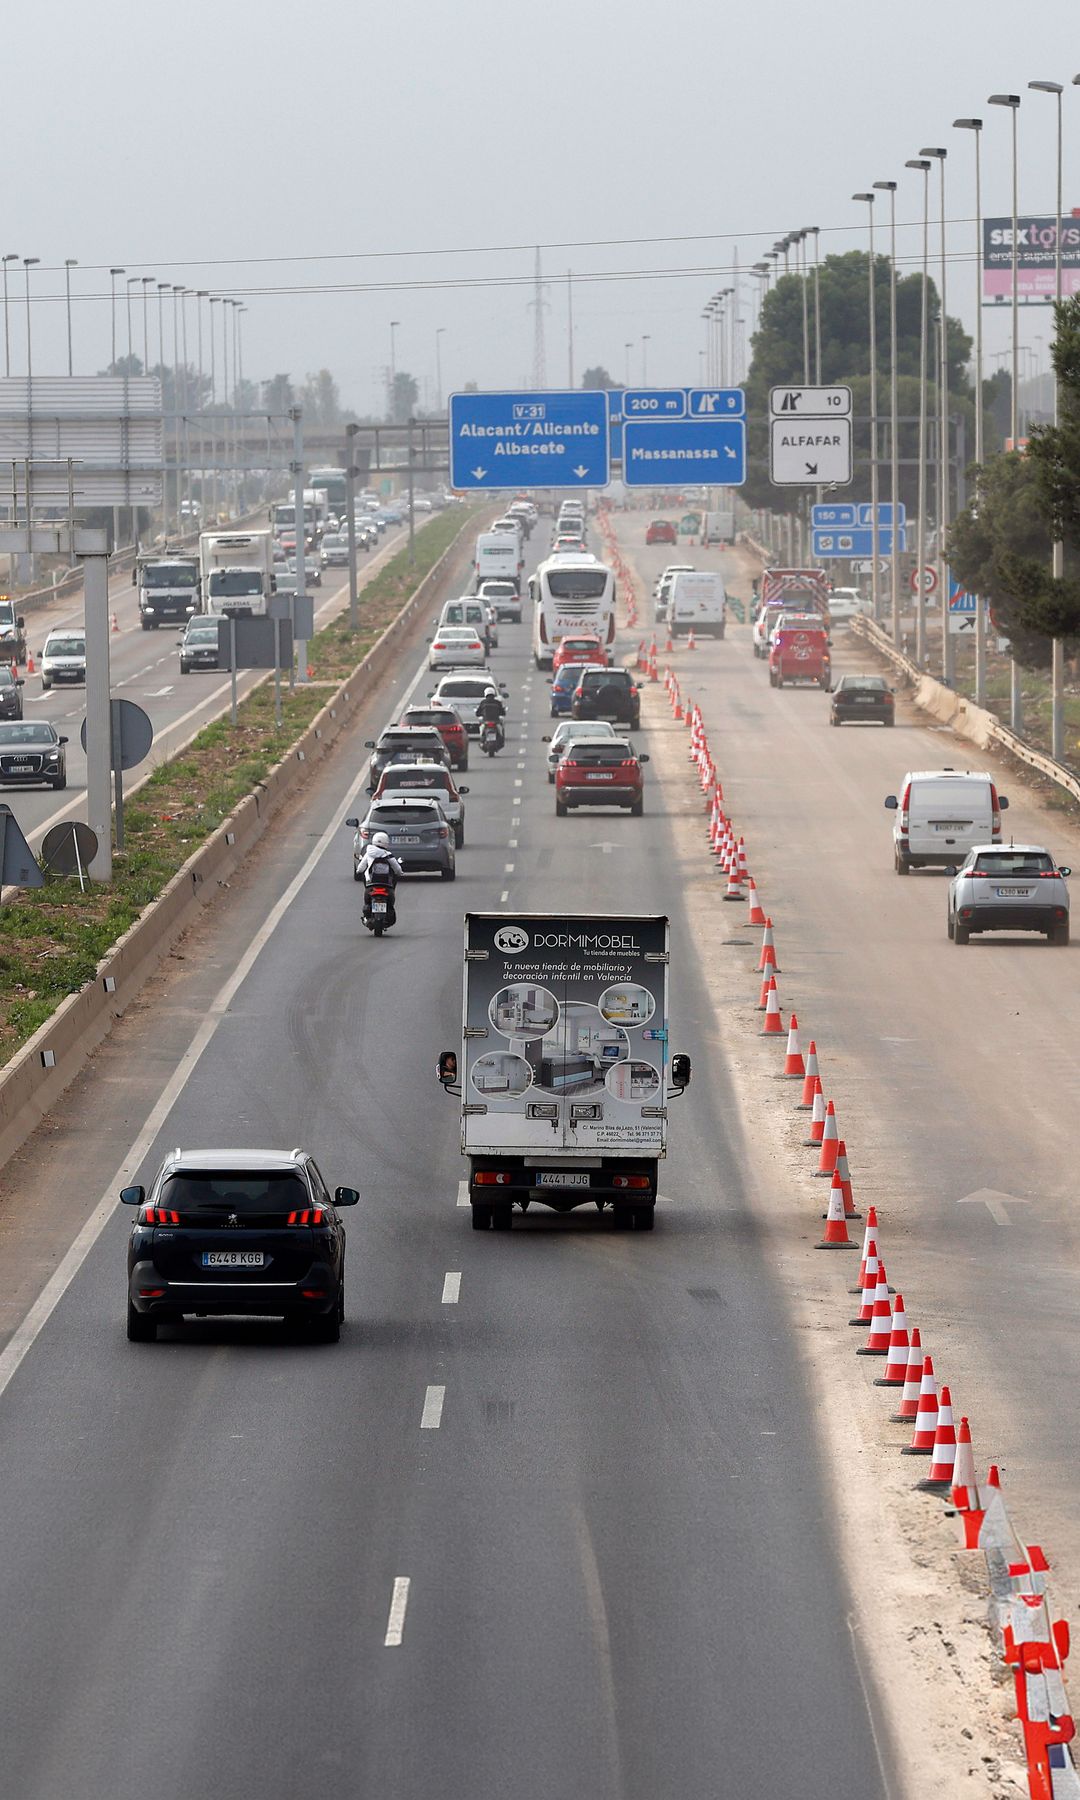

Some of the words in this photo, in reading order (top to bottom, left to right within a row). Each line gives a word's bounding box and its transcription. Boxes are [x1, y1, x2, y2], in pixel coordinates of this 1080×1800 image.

[631, 399, 659, 410] 200
[665, 400, 677, 409] m
[727, 397, 736, 408] 9
[827, 396, 841, 406] 10
[515, 406, 544, 417] V-31
[460, 422, 599, 437] Alacant/Alicante
[781, 435, 841, 447] ALFAFAR
[494, 441, 565, 456] Albacete
[631, 448, 719, 460] Massanassa
[817, 511, 836, 520] 150
[840, 512, 851, 520] m
[533, 934, 641, 949] DORMIMOBEL
[503, 962, 512, 970] Tu
[542, 962, 568, 971] tienda
[570, 962, 581, 971] de
[583, 962, 625, 971] mobiliario
[626, 965, 632, 973] y
[503, 971, 548, 980] decoración
[551, 972, 581, 981] infantil
[597, 973, 632, 982] Valencia
[542, 1174, 566, 1184] 4441
[570, 1175, 588, 1185] JJG
[209, 1253, 237, 1264] 6448
[240, 1253, 261, 1264] KGG
